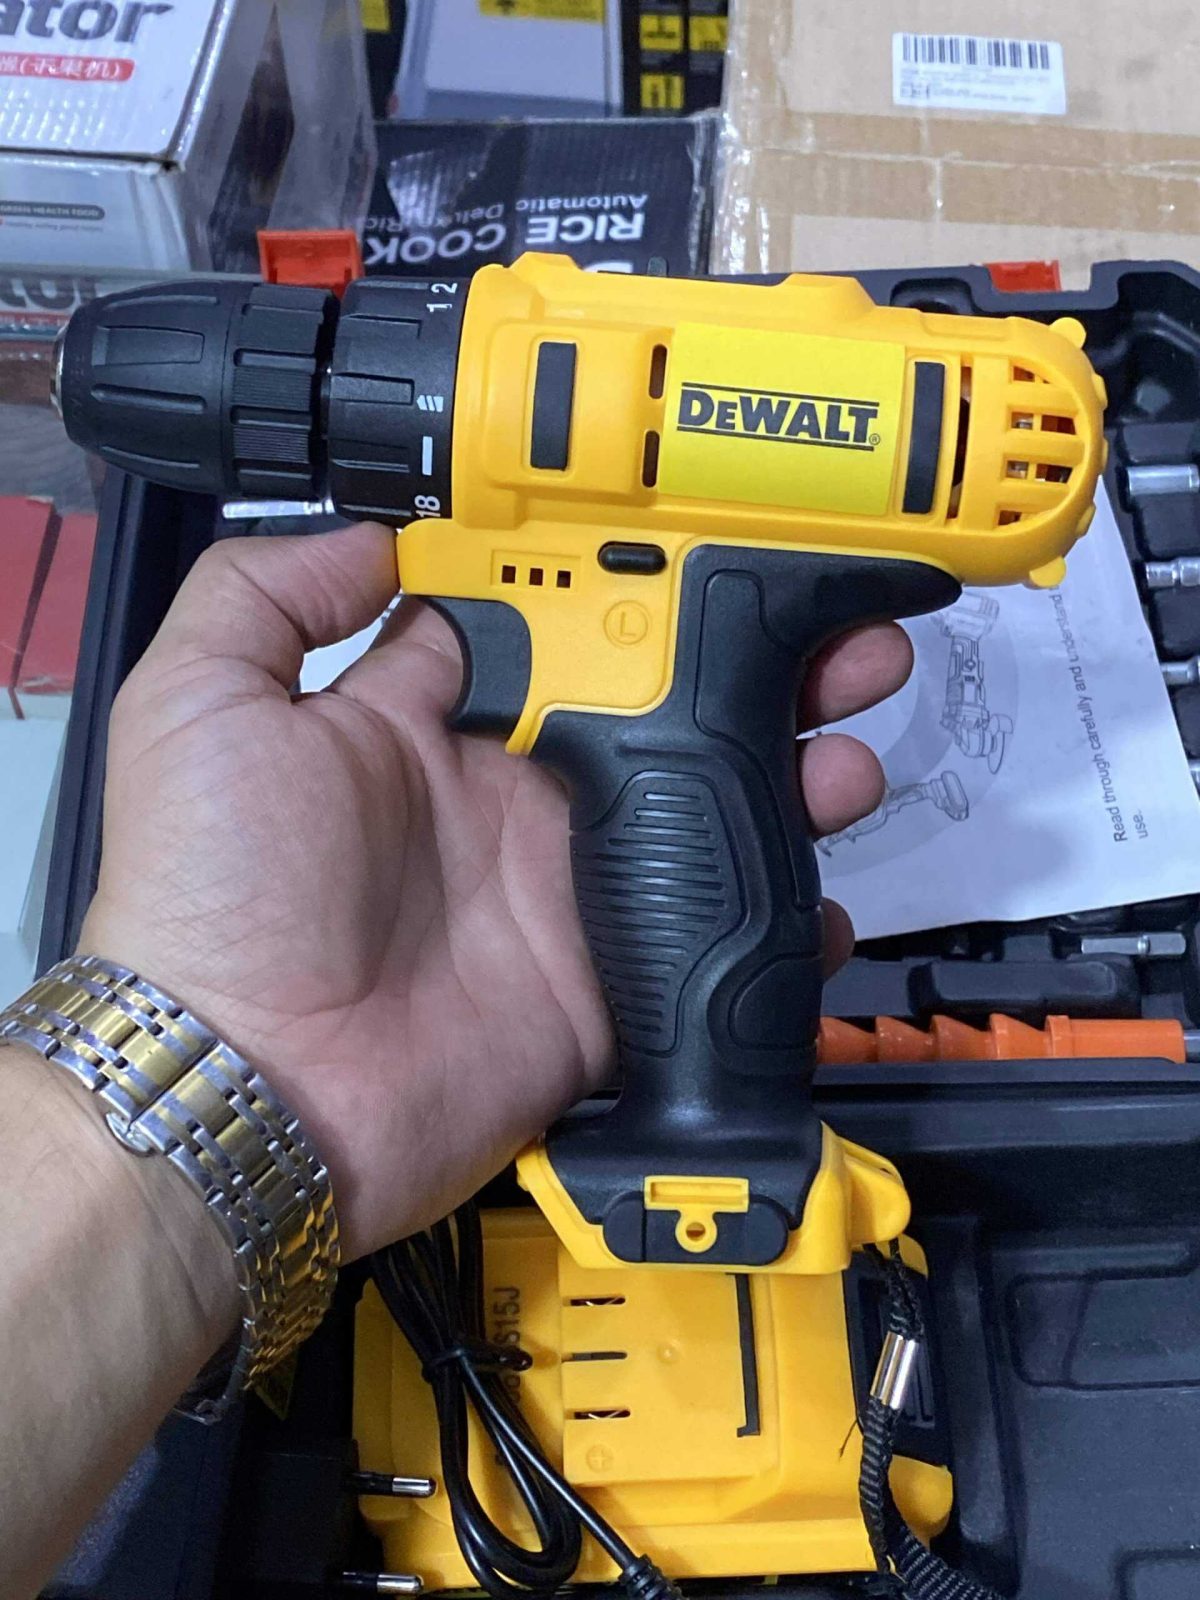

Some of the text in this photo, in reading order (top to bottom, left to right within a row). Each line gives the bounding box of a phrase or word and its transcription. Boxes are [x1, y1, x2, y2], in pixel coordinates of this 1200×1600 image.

[515, 194, 648, 213] Automatic
[525, 213, 645, 244] RICE
[431, 282, 458, 294] 2
[414, 494, 441, 518] 18
[1050, 594, 1128, 842] Read through carefully and understand
[1132, 809, 1149, 840] use.
